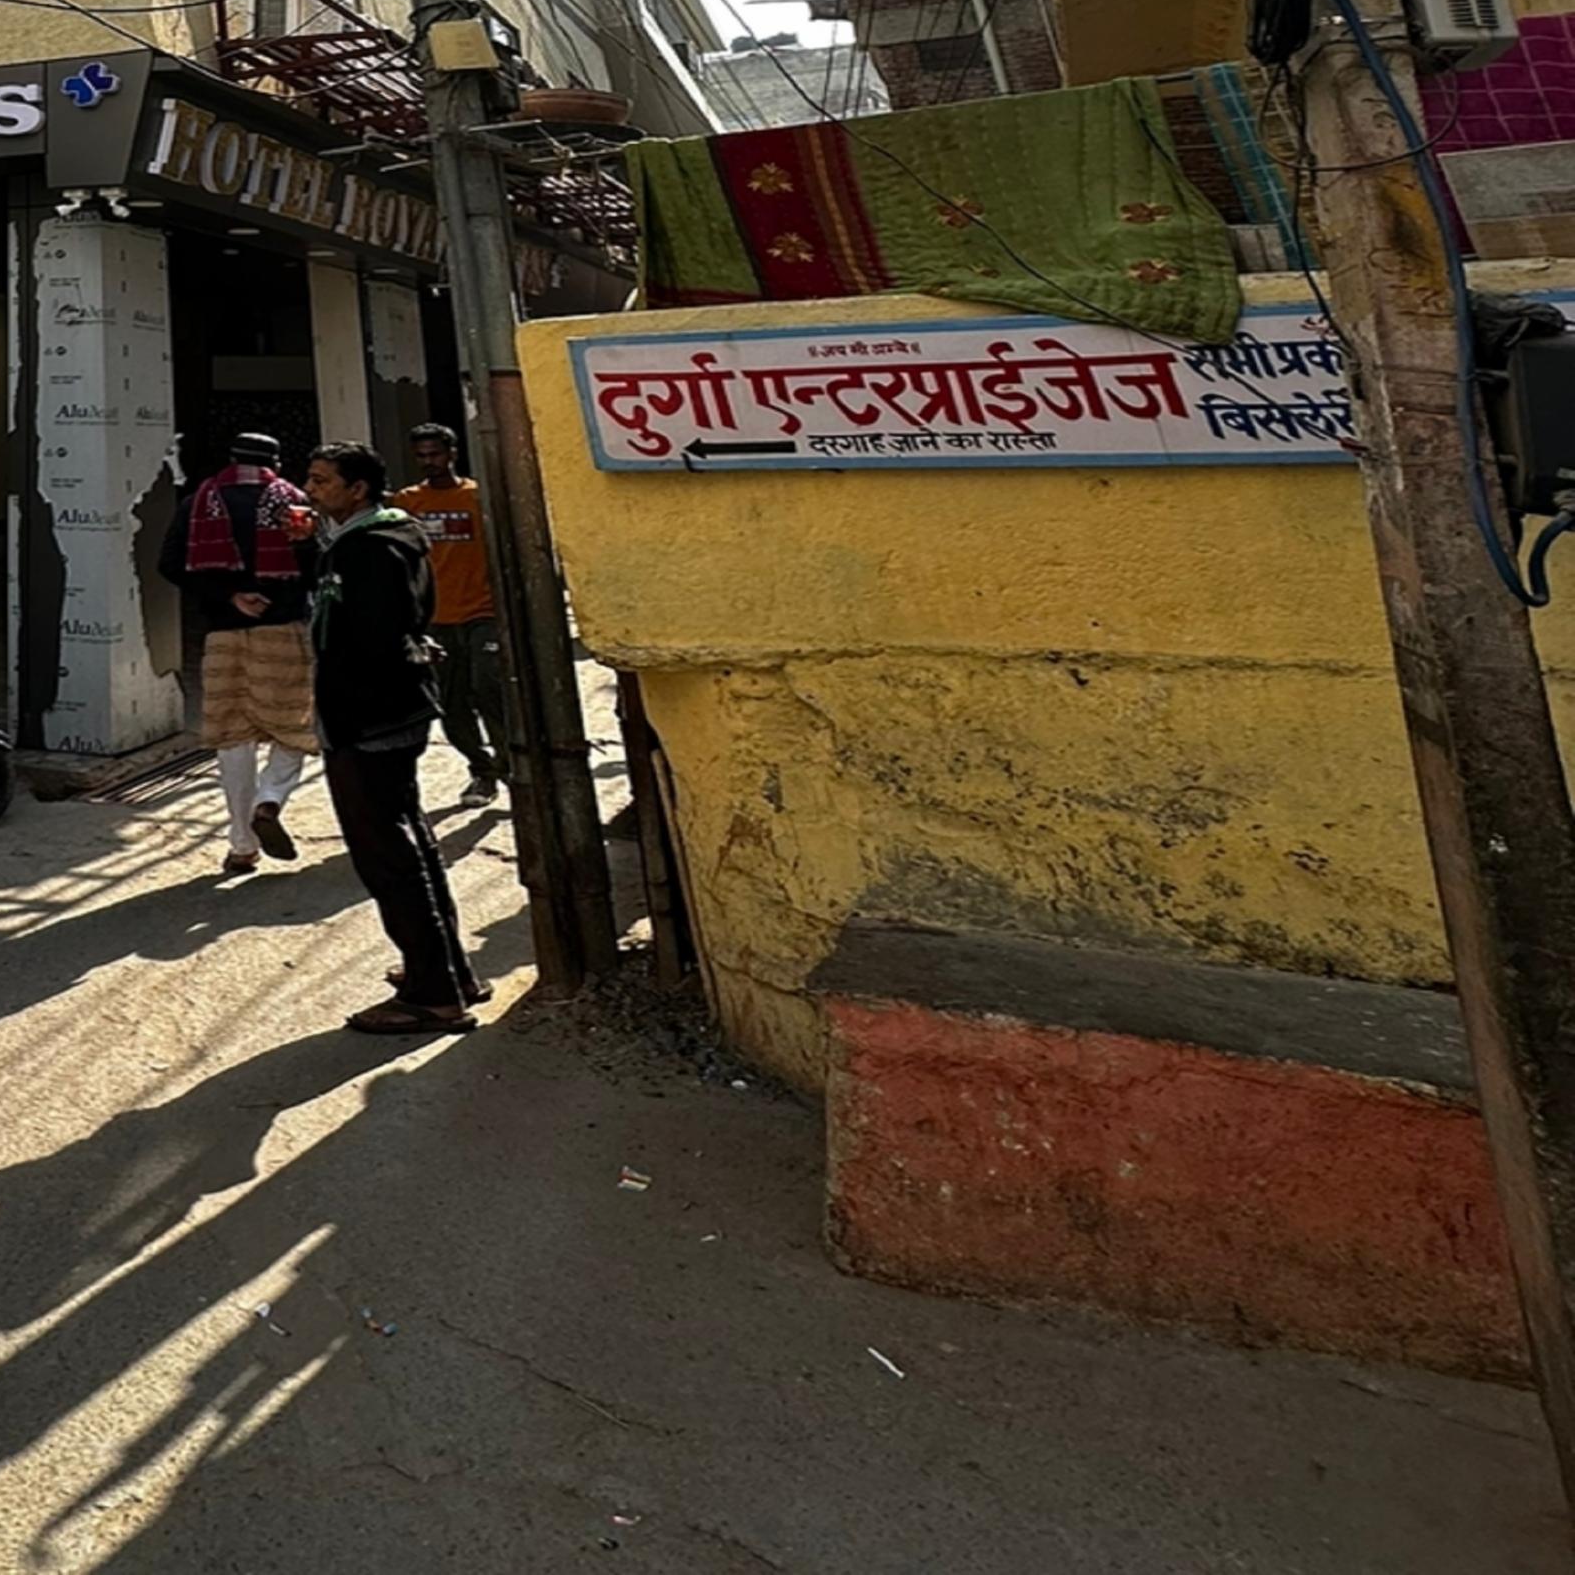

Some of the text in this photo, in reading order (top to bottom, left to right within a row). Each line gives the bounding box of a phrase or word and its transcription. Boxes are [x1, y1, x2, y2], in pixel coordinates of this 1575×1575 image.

[147, 97, 447, 265] HOTEL ROYA
[1183, 332, 1346, 382] सभी प्रक
[594, 352, 738, 457] दुर्गा
[807, 427, 1058, 456] दरगाह जाने का रास्ता
